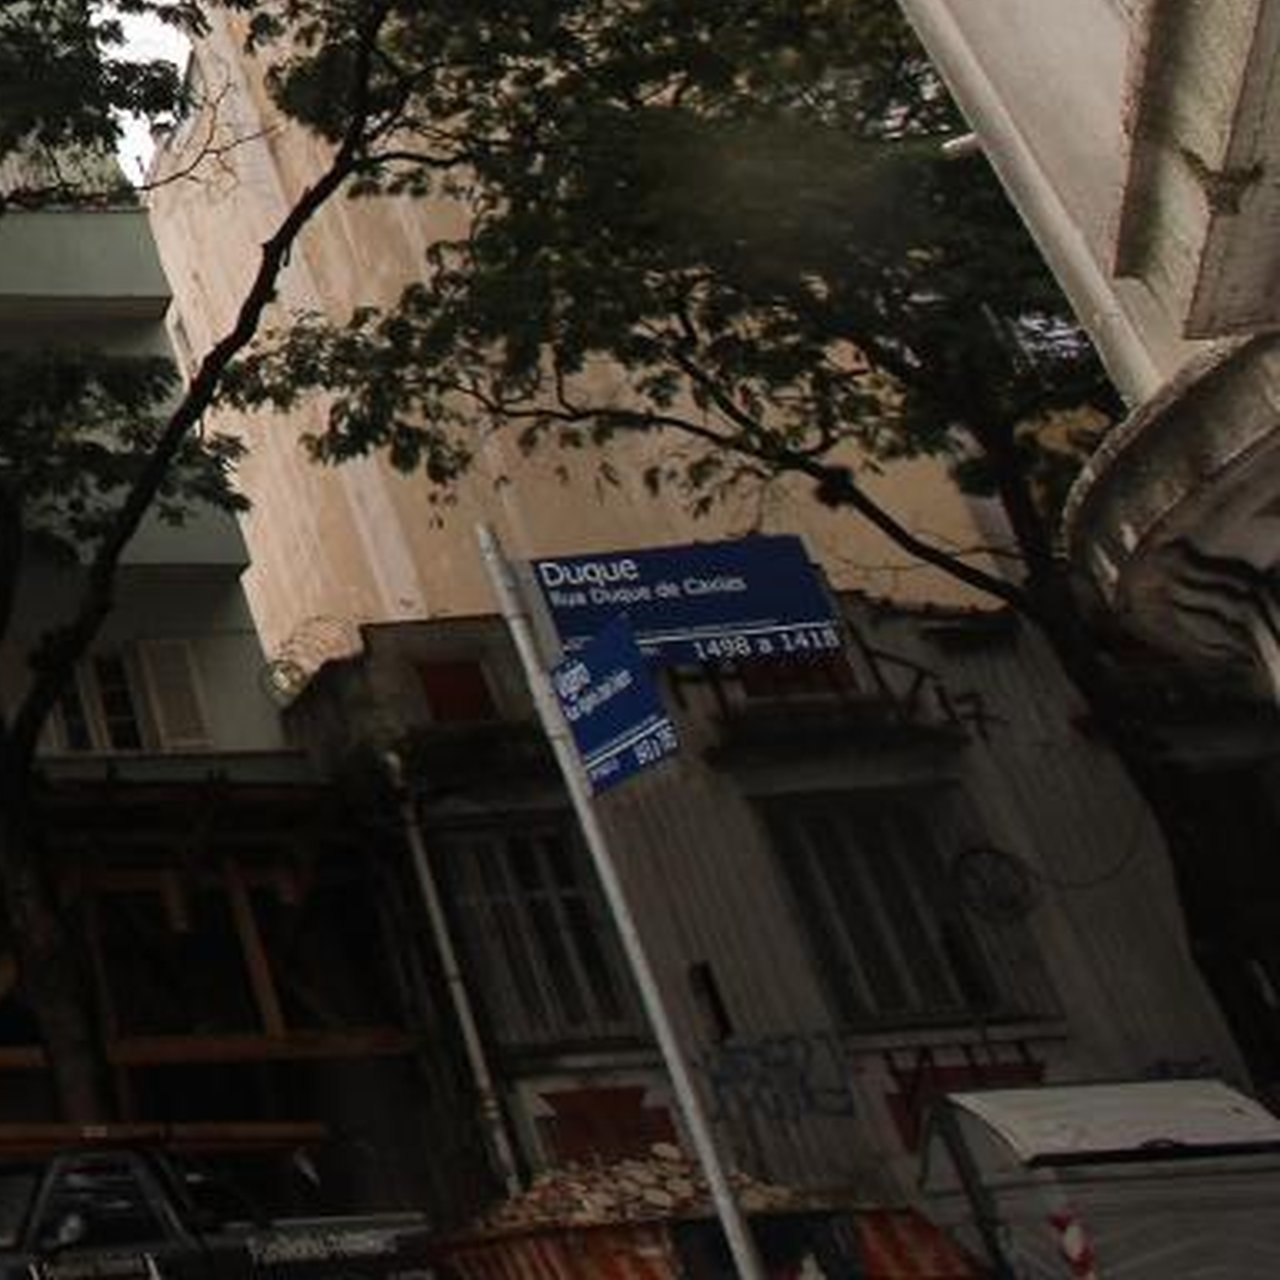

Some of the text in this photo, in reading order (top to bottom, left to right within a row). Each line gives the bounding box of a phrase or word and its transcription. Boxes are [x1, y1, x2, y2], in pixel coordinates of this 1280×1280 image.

[539, 558, 640, 587] Duque
[549, 590, 588, 608] Rua
[590, 585, 652, 606] Duque
[653, 581, 681, 600] de
